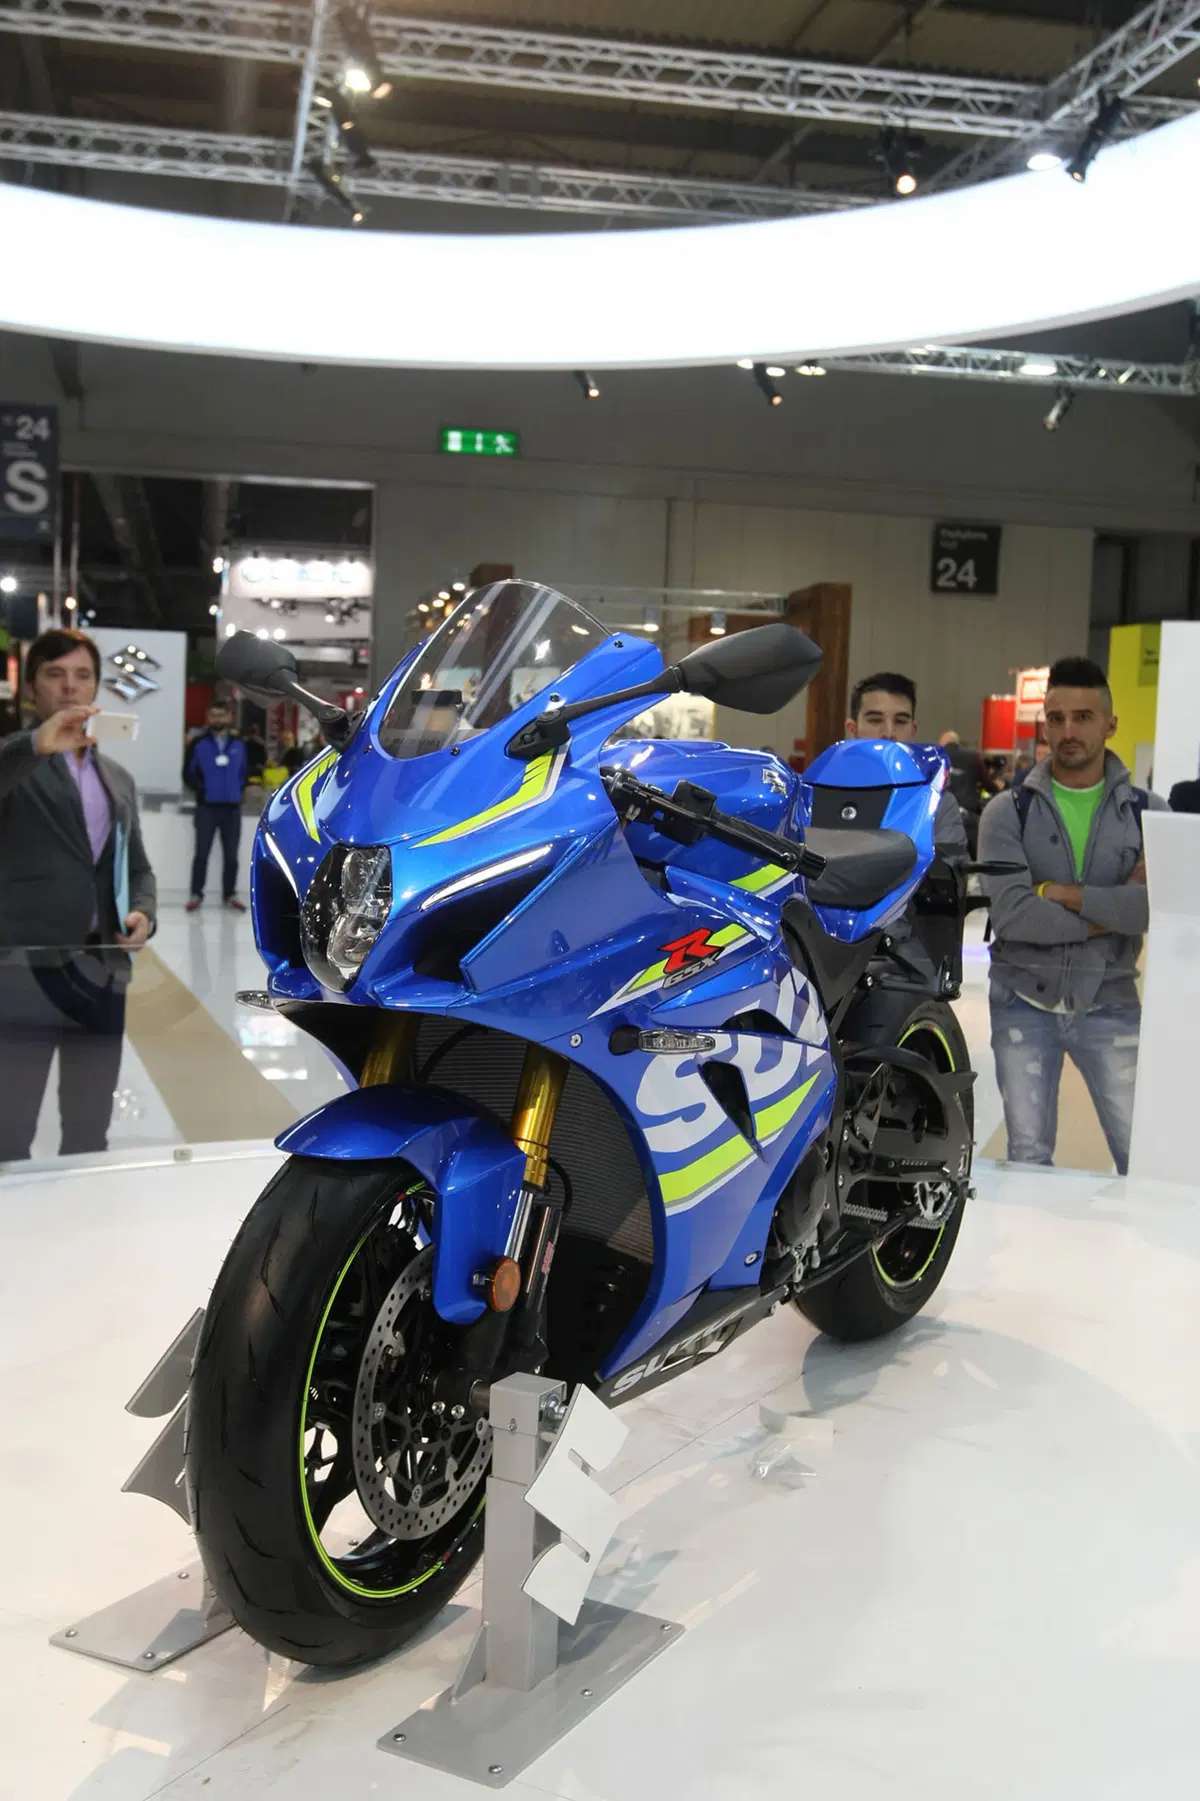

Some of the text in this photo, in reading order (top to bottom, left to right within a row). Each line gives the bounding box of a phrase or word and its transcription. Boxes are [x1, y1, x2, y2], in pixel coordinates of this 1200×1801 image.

[15, 415, 51, 440] 24
[4, 460, 48, 514] S
[936, 556, 978, 589] 24
[662, 951, 720, 989] GSX
